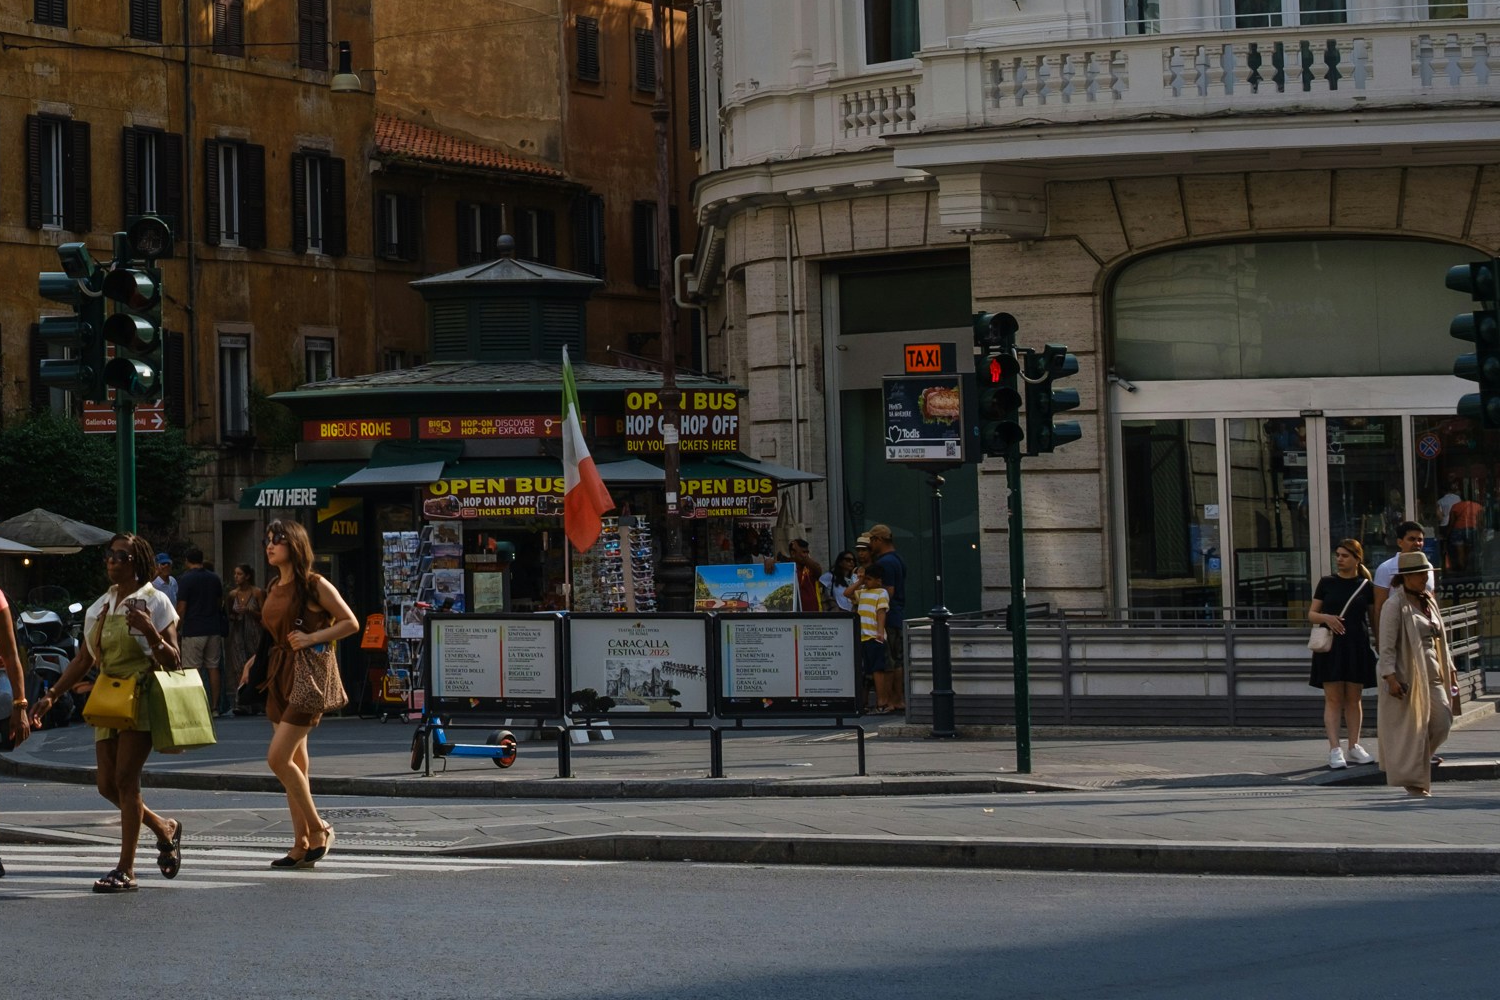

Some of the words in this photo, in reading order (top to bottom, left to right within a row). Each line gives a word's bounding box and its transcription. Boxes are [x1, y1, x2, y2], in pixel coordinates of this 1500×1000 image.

[908, 350, 939, 367] TAXI
[693, 392, 736, 410] BUS
[360, 421, 392, 437] ROME
[460, 419, 493, 428] HOP-ON
[495, 418, 535, 427] DISCOVER
[625, 414, 654, 435] HOP
[680, 414, 708, 435] HOP
[711, 414, 738, 435] OFF
[460, 427, 497, 435] HOP-OFF
[498, 427, 535, 435] EXPLORE
[902, 428, 920, 438] Todis
[627, 440, 645, 451] BUY
[647, 440, 665, 451] YOU
[678, 440, 708, 451] ICKETS
[711, 440, 737, 451] HERE
[429, 478, 506, 496] OPEN
[515, 477, 564, 494] BUS
[733, 478, 773, 494] BUS
[254, 489, 284, 507] ATM
[285, 488, 317, 506] HERE
[463, 496, 482, 508] HOP
[483, 496, 497, 507] ON
[499, 495, 517, 507] HOP
[518, 495, 535, 506] OFF
[696, 497, 709, 507] HOP
[710, 497, 720, 507] ON
[721, 496, 734, 507] HOP
[735, 496, 748, 507] OFF
[478, 507, 512, 517] TICKETS
[513, 507, 536, 515] HERE
[707, 508, 731, 516] TICKETS
[733, 508, 748, 516] HERE
[330, 520, 359, 536] ATM
[608, 639, 670, 648] CARACALLA
